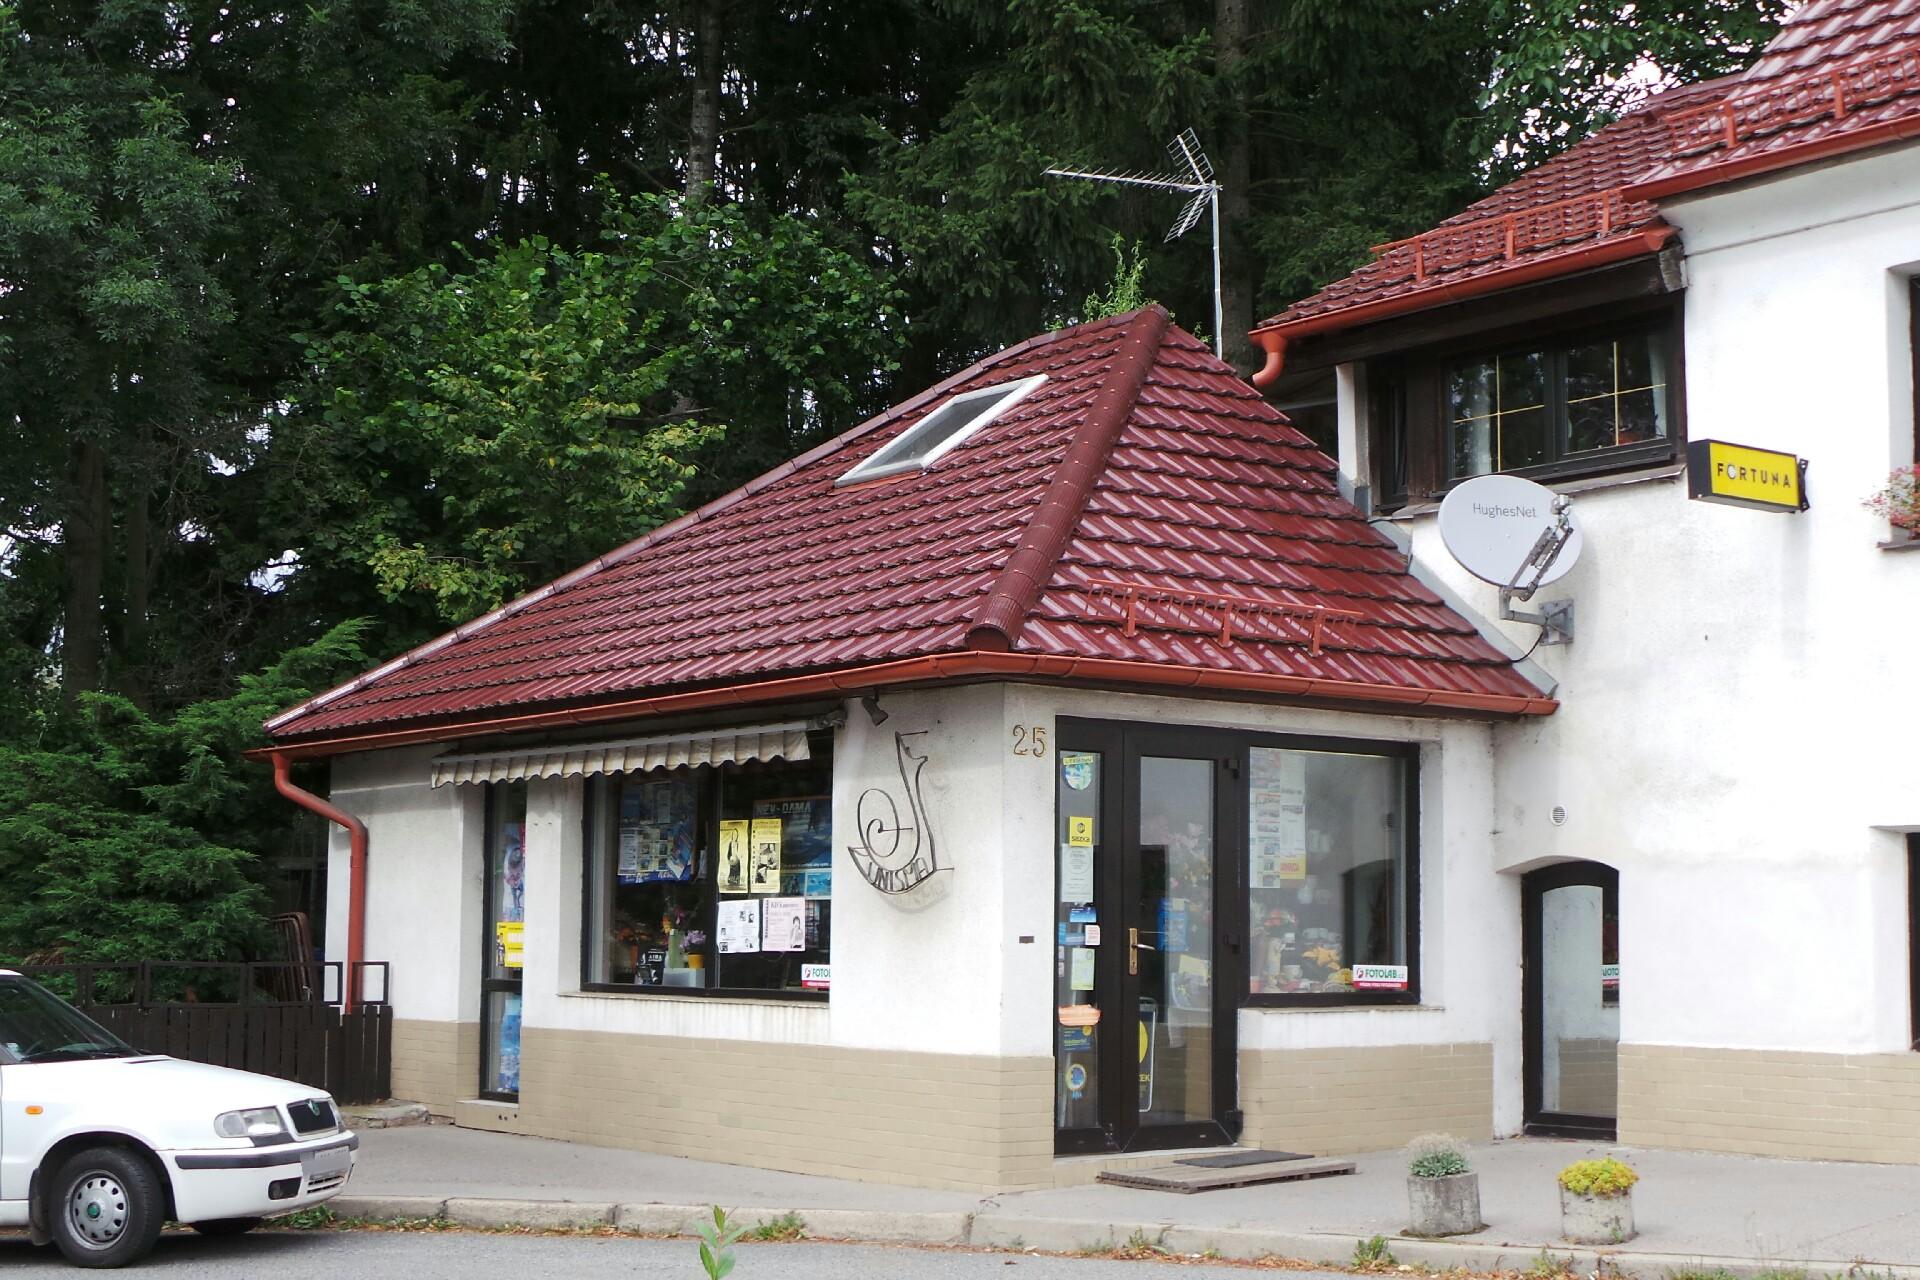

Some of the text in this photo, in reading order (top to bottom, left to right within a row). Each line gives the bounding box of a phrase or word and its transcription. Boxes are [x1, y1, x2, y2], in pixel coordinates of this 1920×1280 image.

[1717, 462, 1791, 489] FORTUNA
[1472, 502, 1537, 519] HughesNet
[1012, 724, 1047, 758] 25
